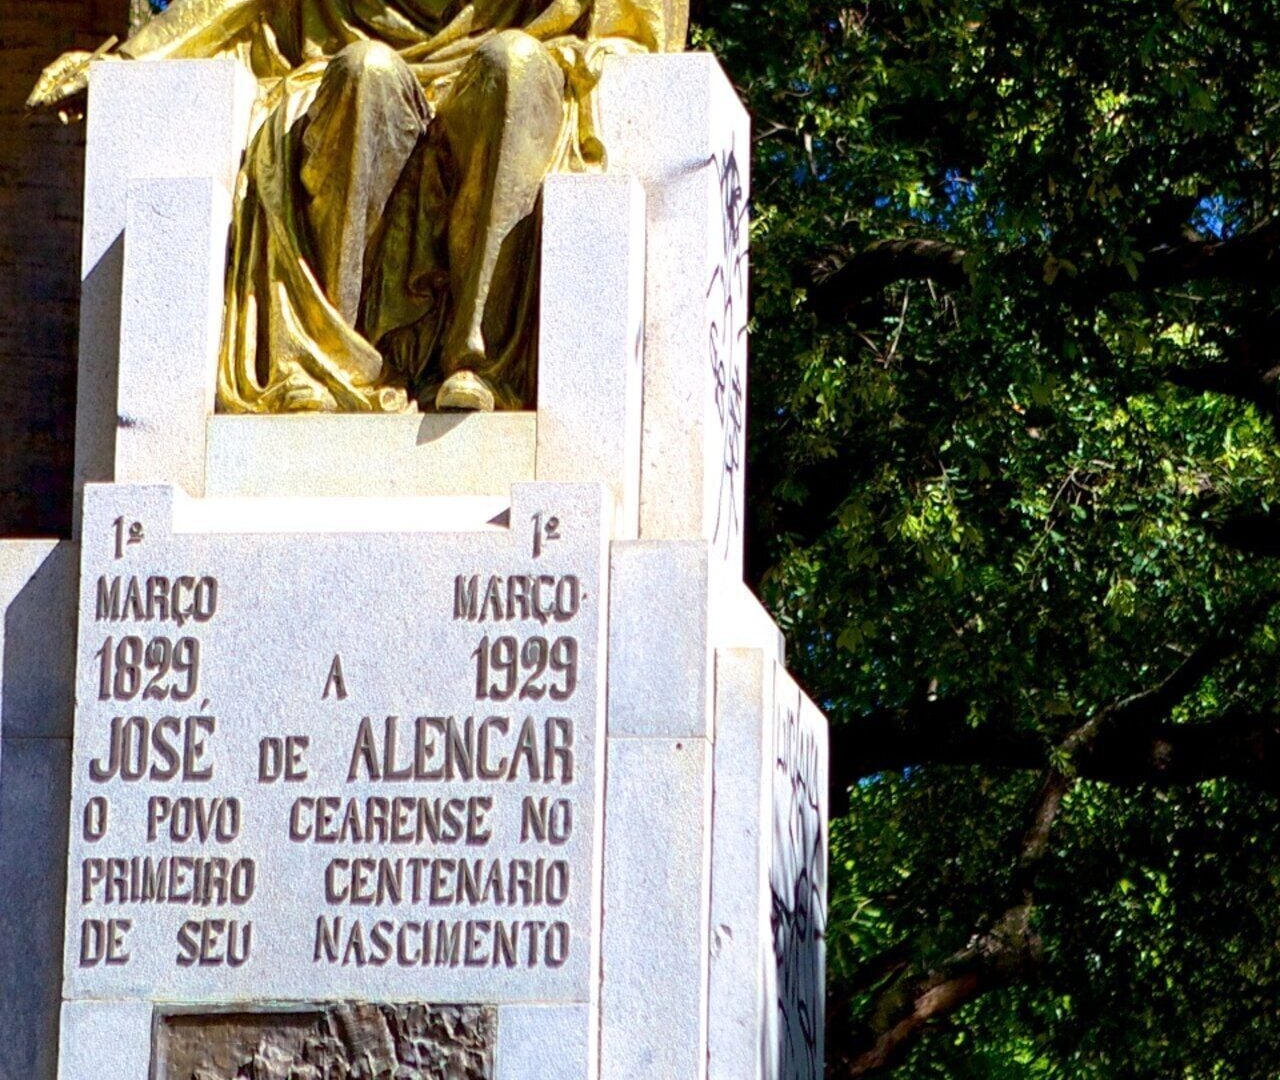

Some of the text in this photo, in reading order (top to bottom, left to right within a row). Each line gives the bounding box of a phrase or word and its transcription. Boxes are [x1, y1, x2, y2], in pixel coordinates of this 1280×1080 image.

[95, 574, 218, 627] MARÇO
[452, 574, 580, 626] MARÇO
[94, 635, 199, 701] 1829
[321, 654, 348, 700] A
[471, 635, 578, 701] 1929
[89, 698, 574, 784] JOSÉ DE ALENCAR
[83, 796, 573, 844] O POVO CEARENSE NO
[81, 857, 569, 907] PRIMEIRO CENTENARIO
[79, 915, 569, 968] DE SEU NASCIMENTO
